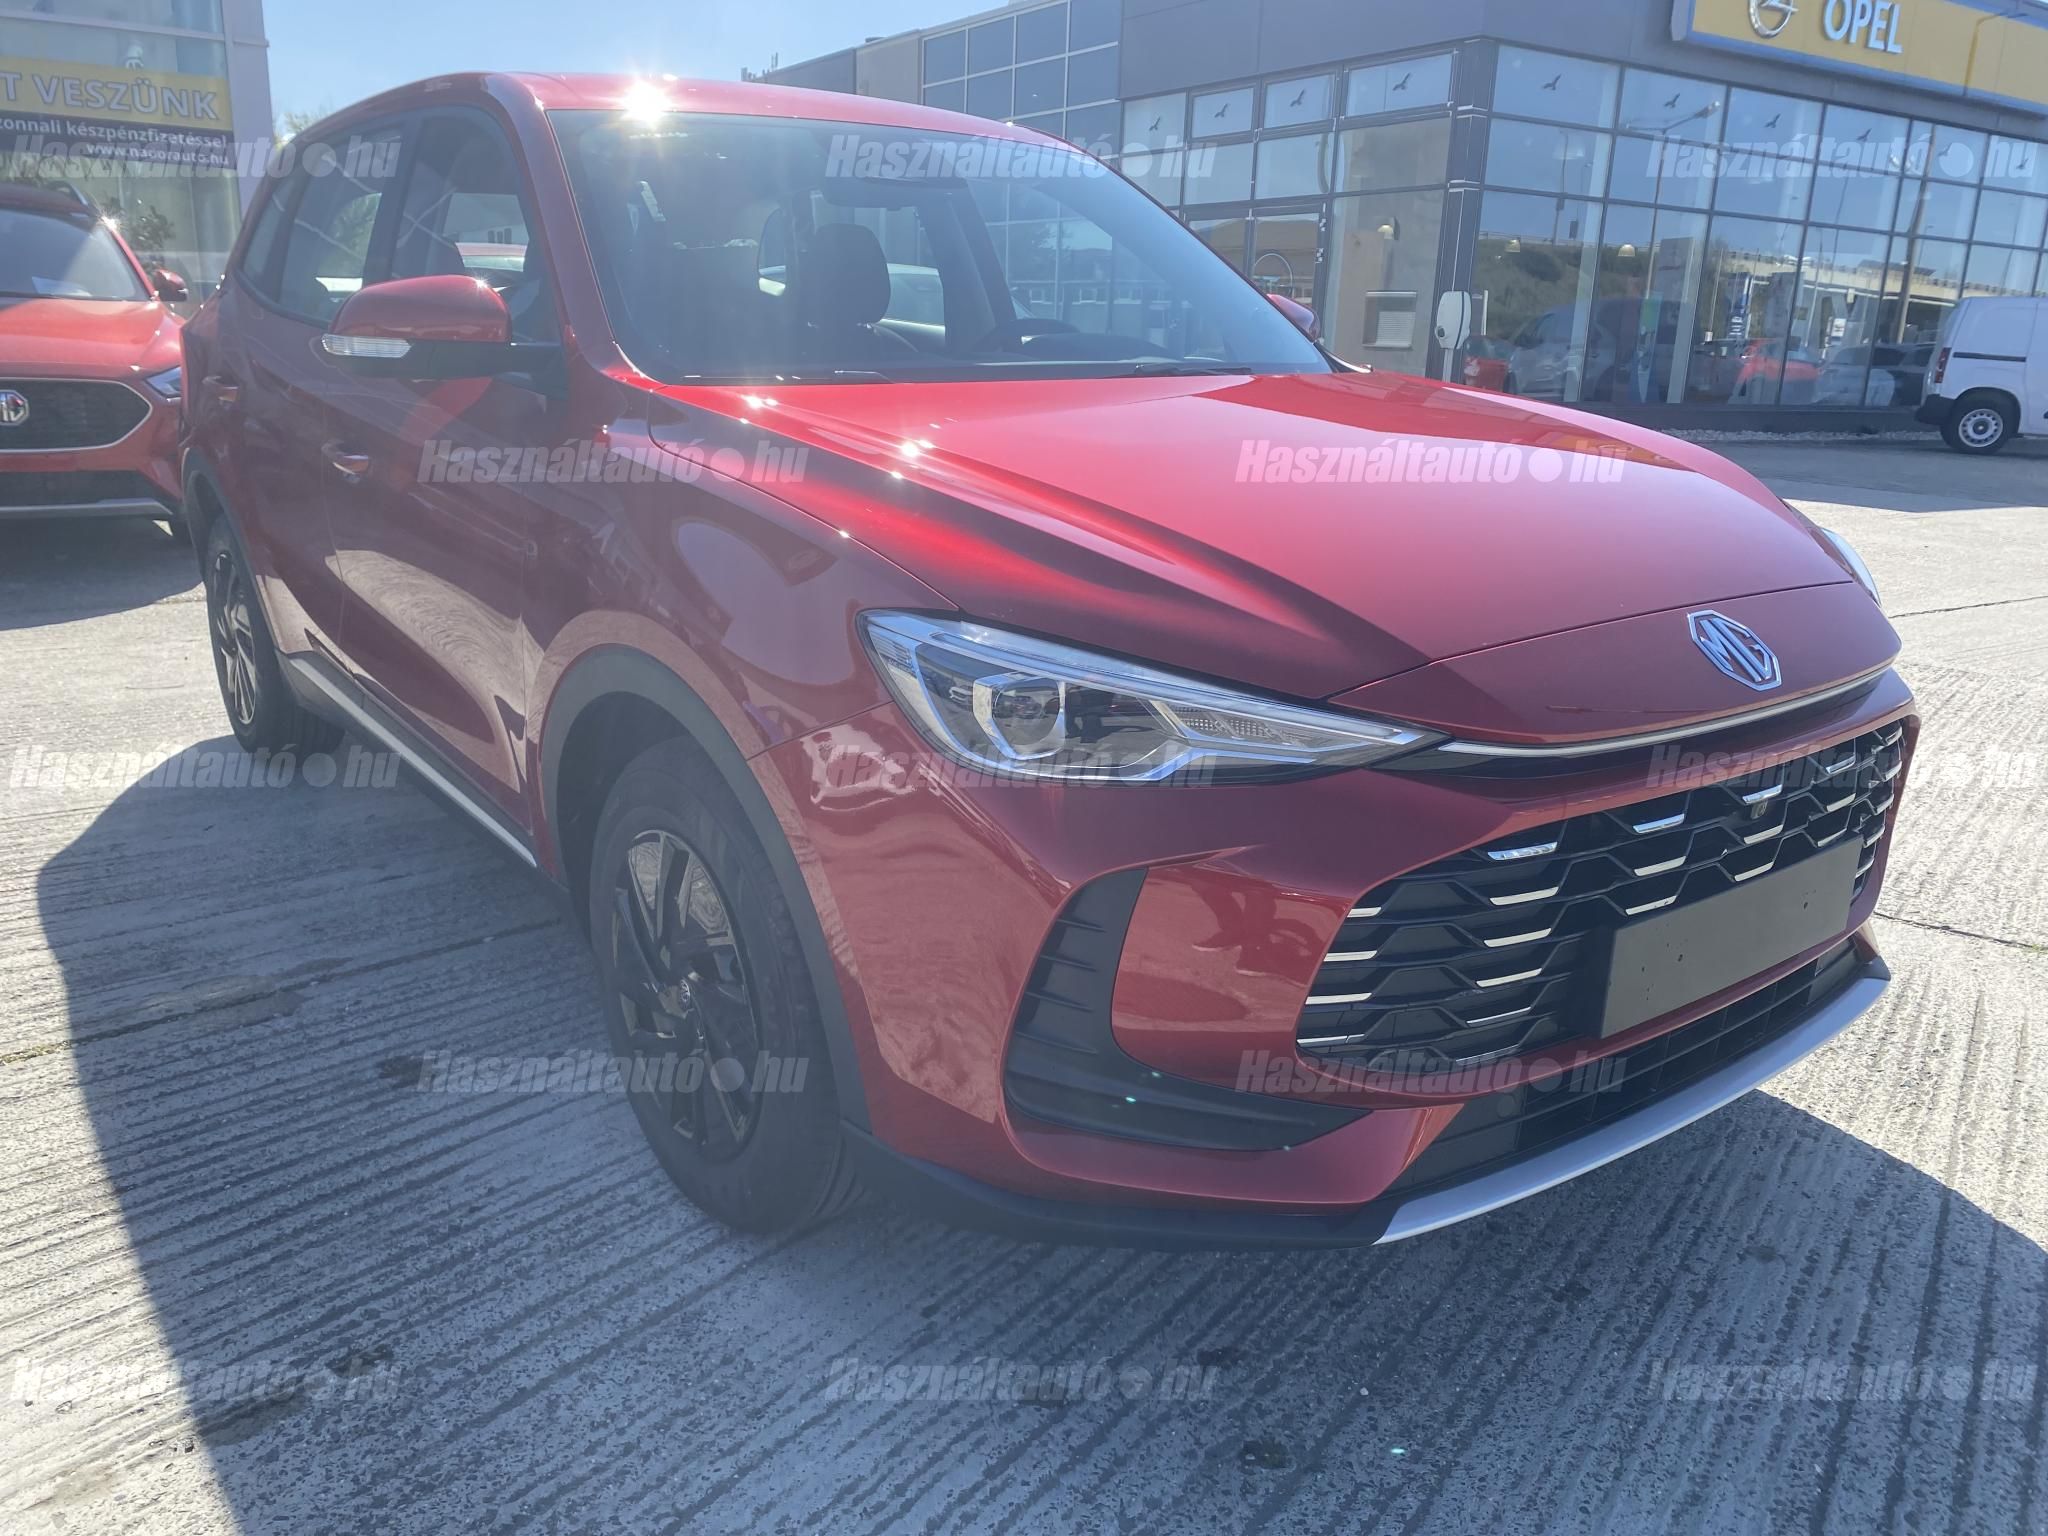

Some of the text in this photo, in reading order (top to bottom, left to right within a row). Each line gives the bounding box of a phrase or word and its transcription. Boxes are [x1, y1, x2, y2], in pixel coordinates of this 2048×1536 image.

[1823, 0, 1904, 54] OPEL
[32, 74, 219, 120] VESZÜNK
[0, 117, 226, 148] onnali készpénzfizetéssel
[1697, 616, 1774, 684] MG
